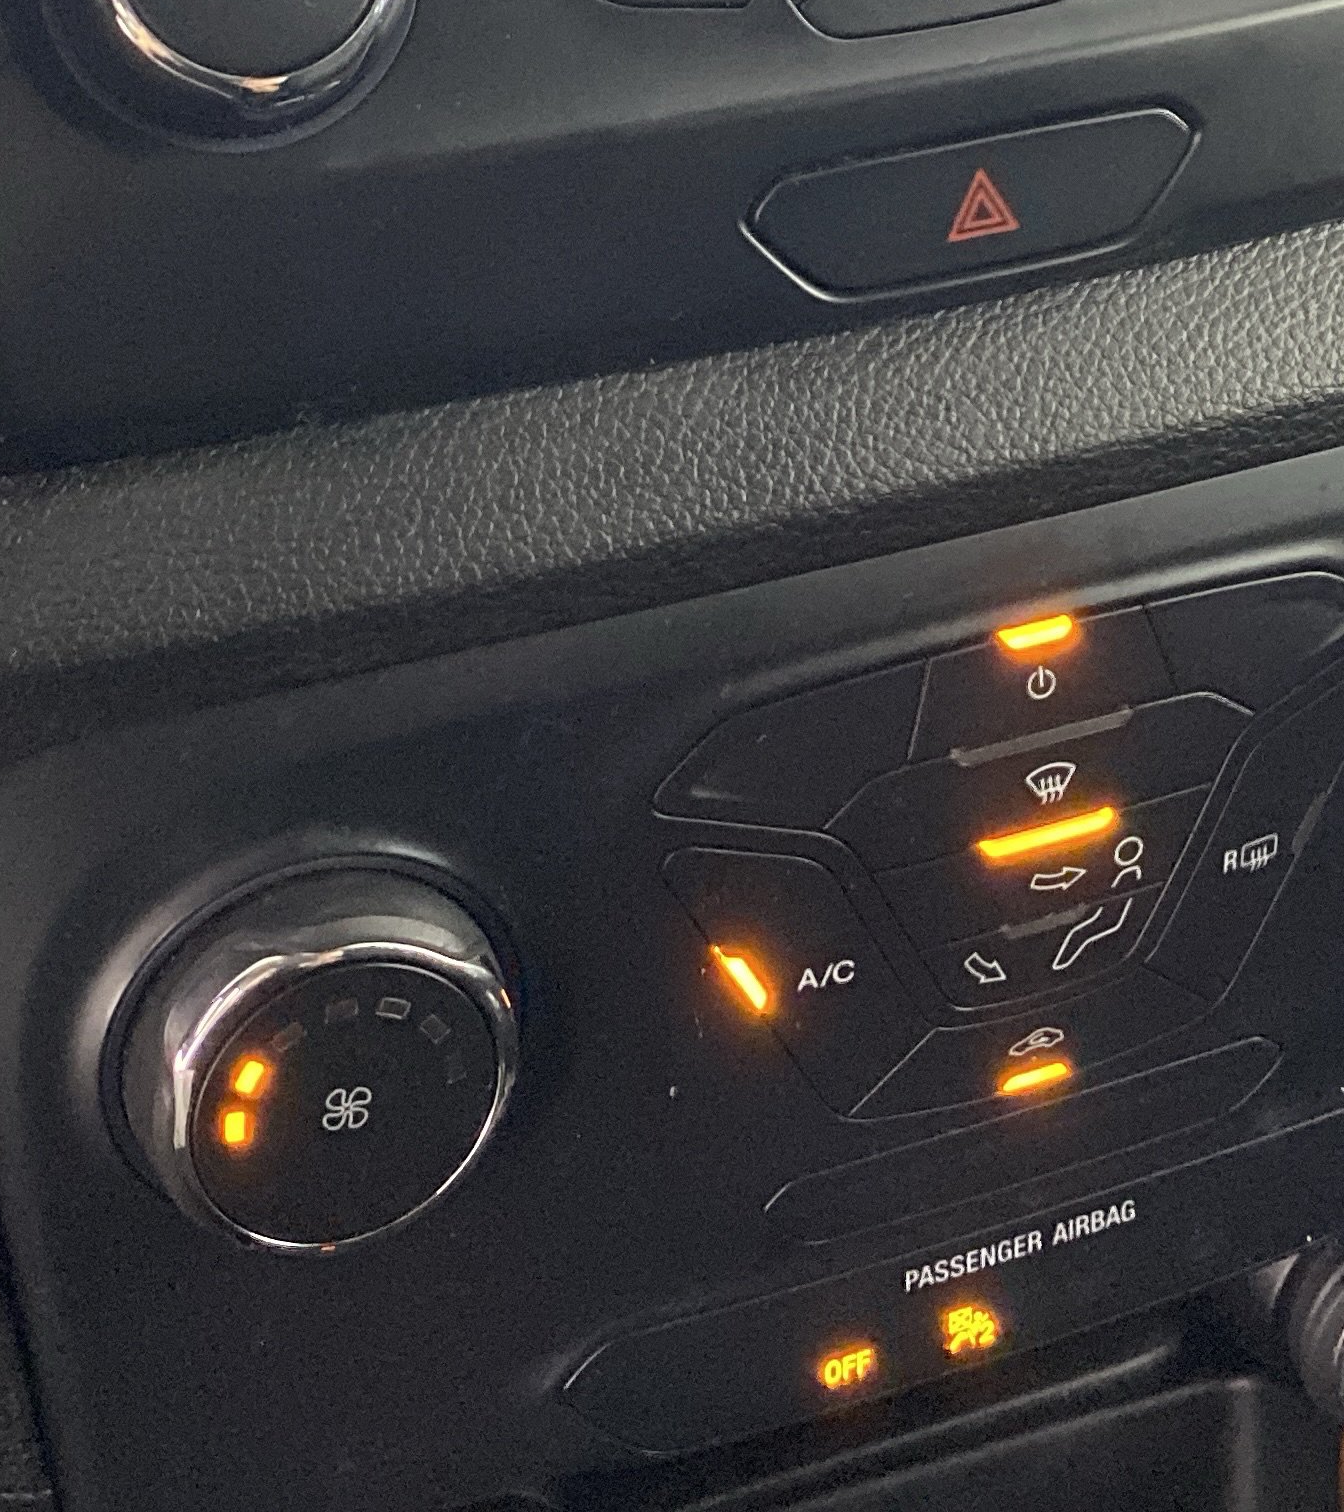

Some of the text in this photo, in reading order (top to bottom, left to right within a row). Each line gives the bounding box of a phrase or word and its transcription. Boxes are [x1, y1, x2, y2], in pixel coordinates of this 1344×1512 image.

[797, 958, 856, 993] A/C
[903, 1198, 1137, 1293] PASSENGER AIRBAG
[822, 1347, 874, 1390] OFF
